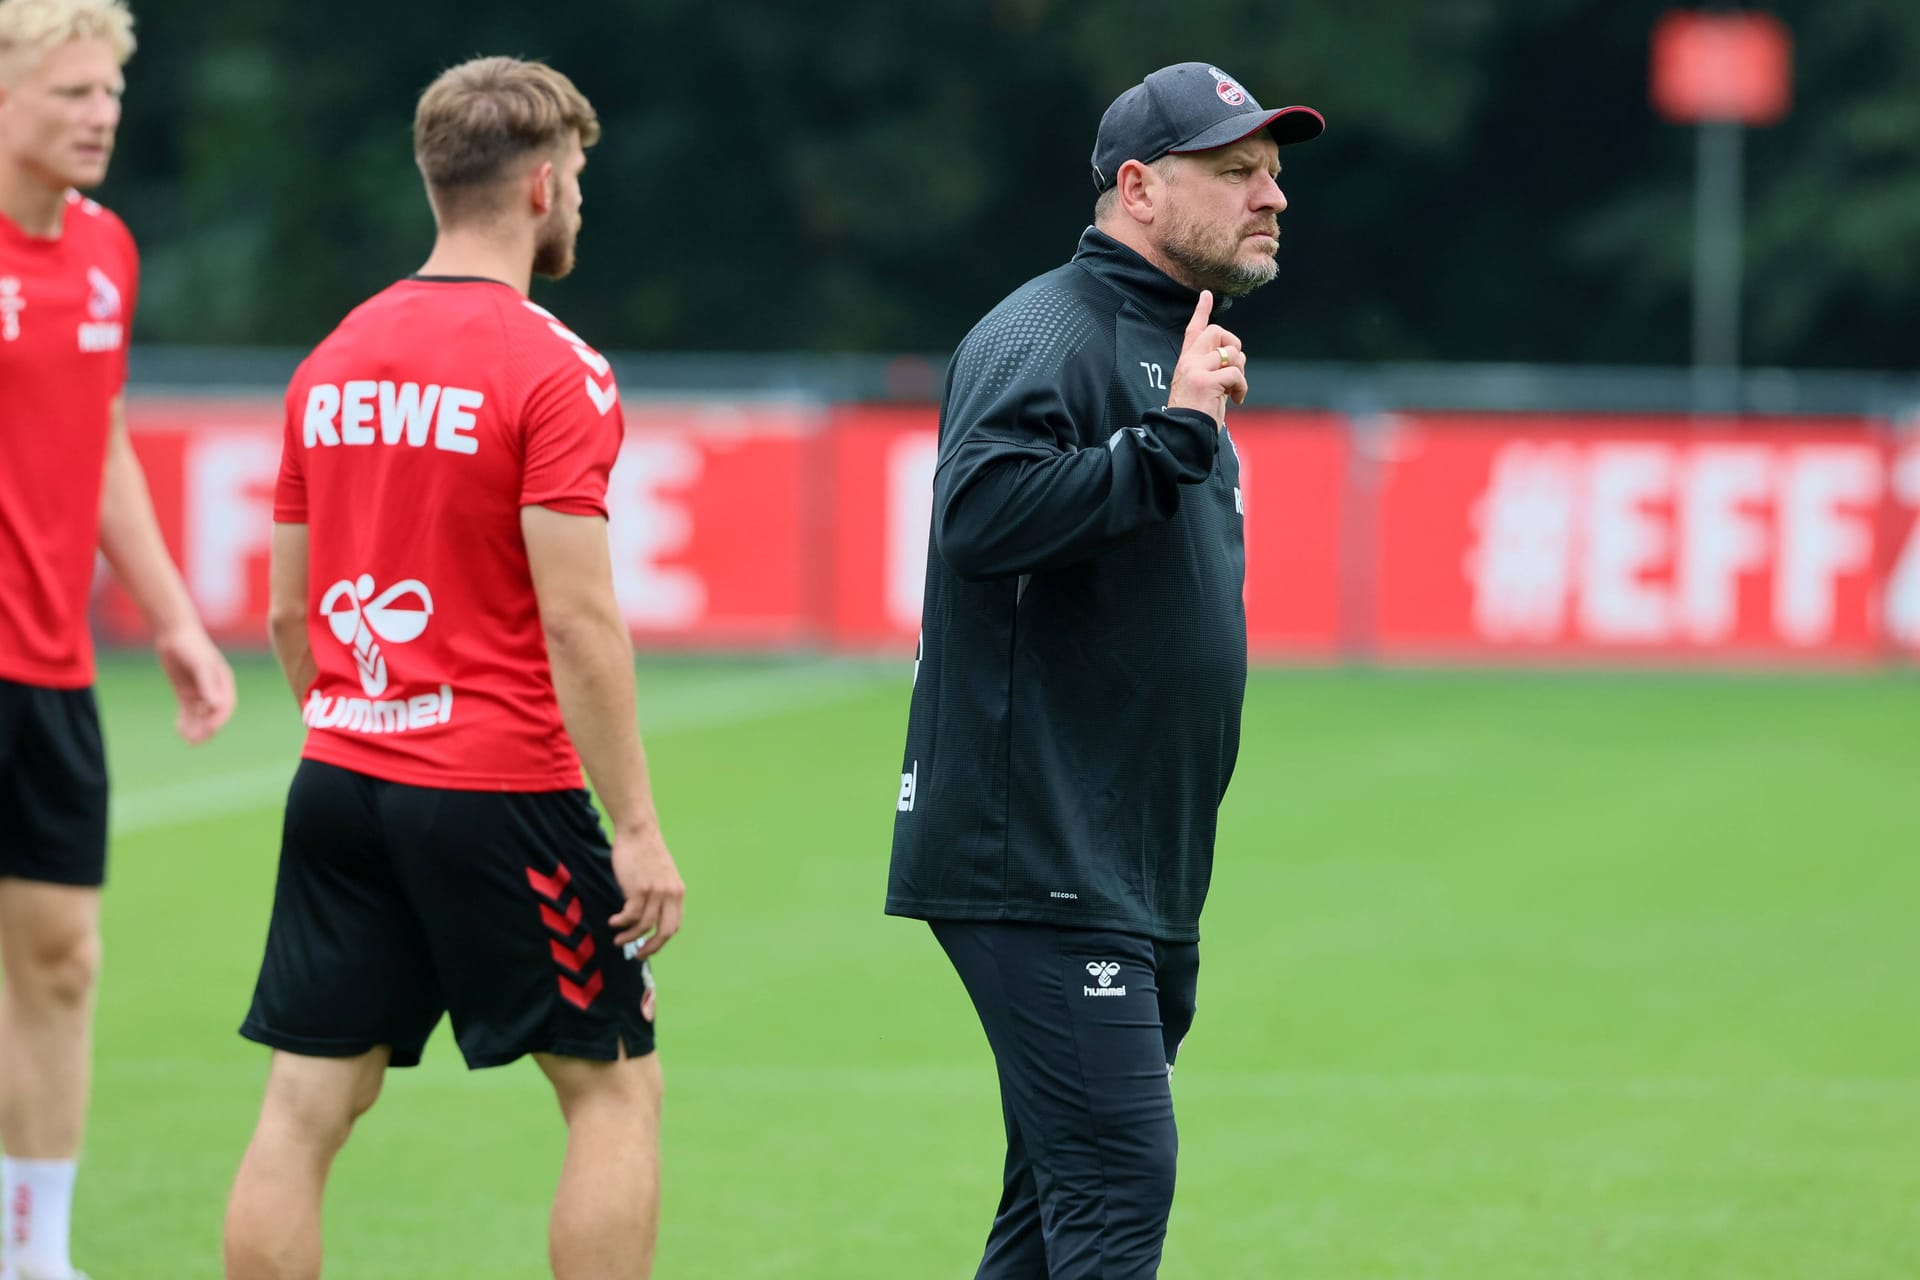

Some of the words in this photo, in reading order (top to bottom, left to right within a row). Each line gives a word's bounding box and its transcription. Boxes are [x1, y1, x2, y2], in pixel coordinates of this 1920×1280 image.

[1140, 361, 1167, 390] 72
[303, 380, 484, 455] REWE
[303, 684, 453, 733] hummel
[1083, 985, 1126, 997] hummel
